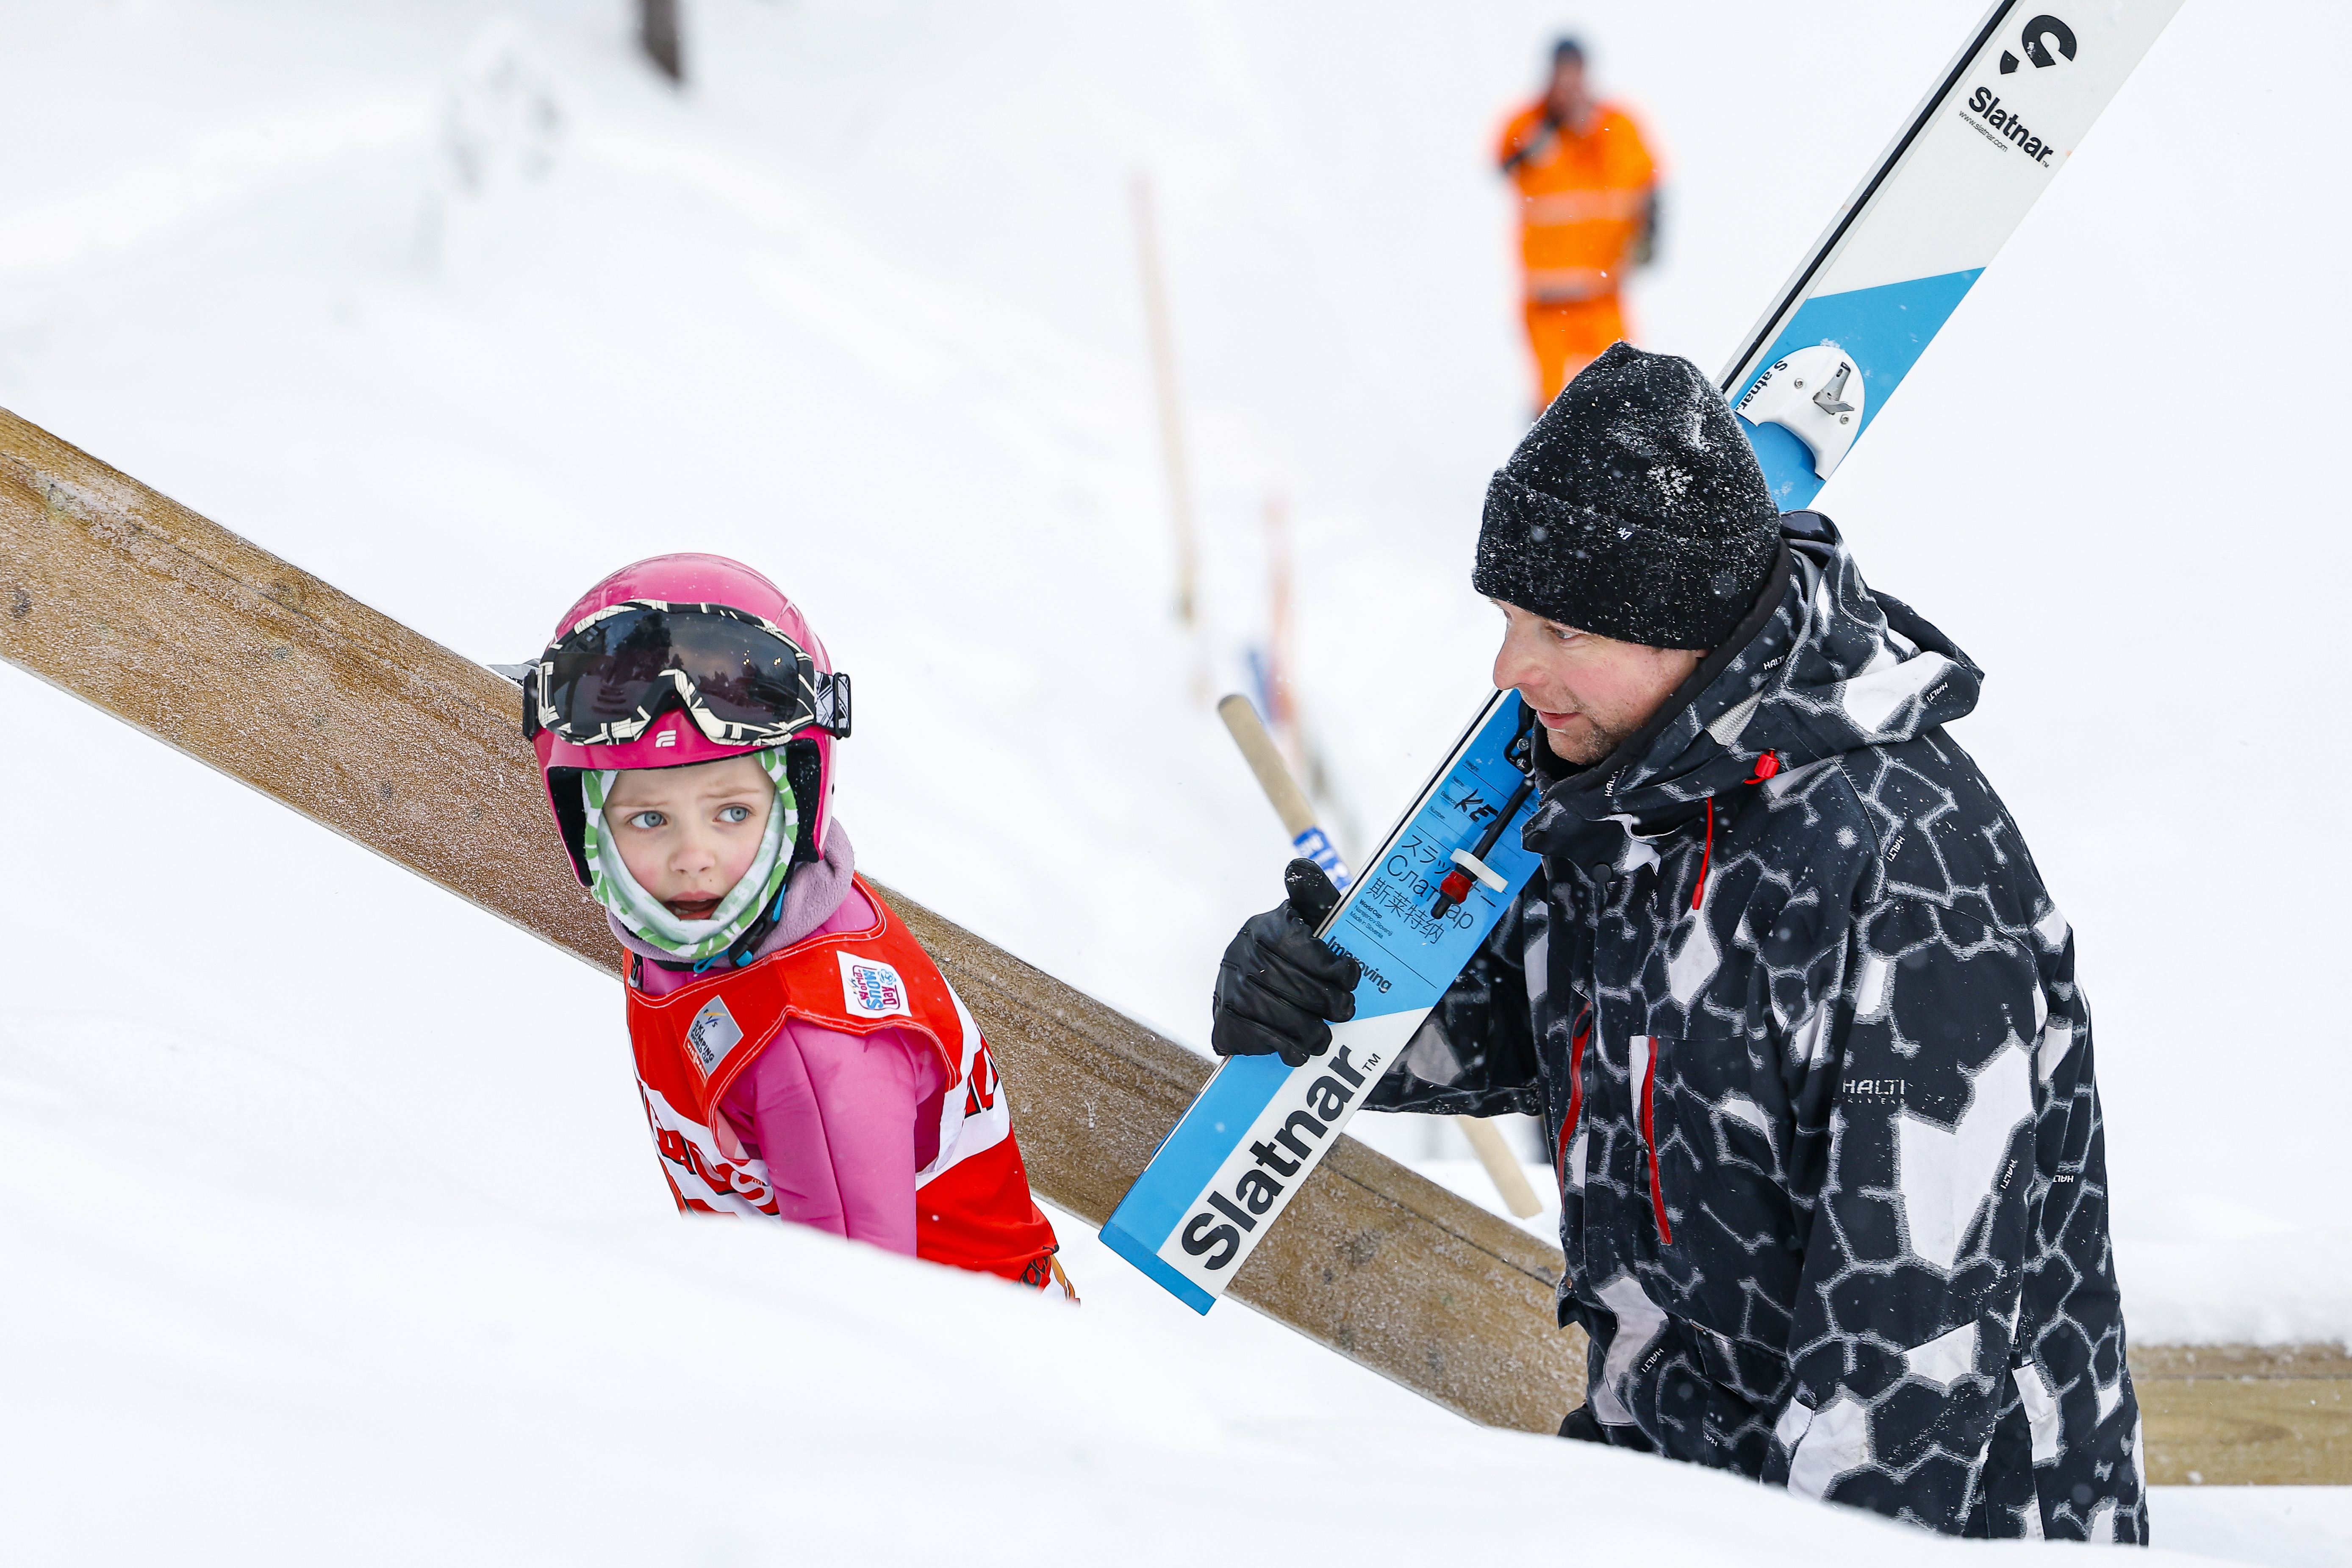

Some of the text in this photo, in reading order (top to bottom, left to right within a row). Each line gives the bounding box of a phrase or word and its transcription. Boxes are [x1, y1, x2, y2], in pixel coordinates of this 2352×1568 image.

[1959, 110, 2008, 153] www.slatnar.com
[1969, 86, 2054, 163] Slatnar
[1740, 360, 1788, 410] Satnar
[1926, 682, 1948, 702] HALTI
[1453, 788, 1499, 825] KE
[1886, 835, 1905, 862] HALTI
[1387, 855, 1474, 930] Слатар
[1359, 899, 1382, 919] World Cup
[1366, 877, 1445, 944] 斯莱特纳
[1349, 911, 1362, 923] Made
[1365, 923, 1384, 939] Slovenia
[881, 985, 897, 1005] Day
[695, 1020, 705, 1035] SKI
[691, 1031, 710, 1064] WORLD CUP
[693, 1026, 715, 1062] JUMPING
[1842, 1079, 1905, 1095] HALTI
[1181, 1044, 1367, 1270] Slatnar
[2000, 1158, 2018, 1189] HALTI
[2053, 1175, 2074, 1183] HALT
[1641, 1348, 1664, 1373] HALTI
